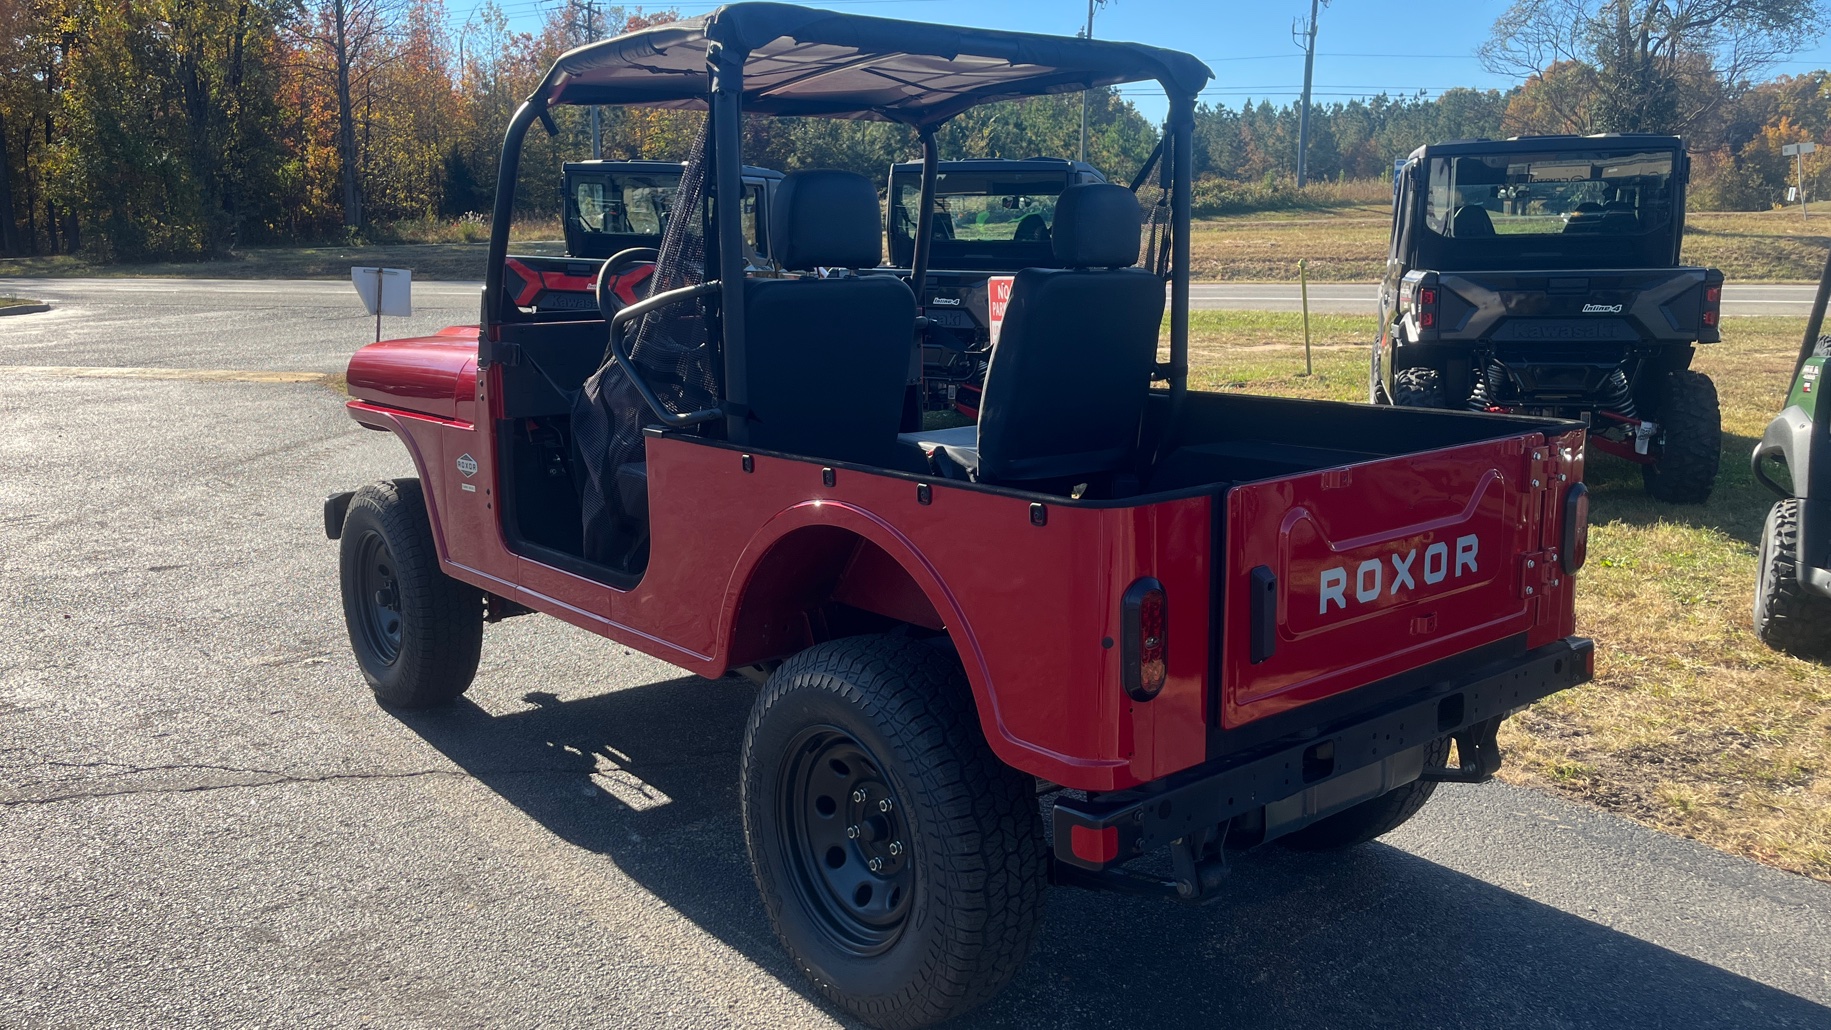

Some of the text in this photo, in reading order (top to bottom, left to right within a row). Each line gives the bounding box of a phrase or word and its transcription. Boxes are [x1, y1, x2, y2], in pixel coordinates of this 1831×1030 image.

[997, 285, 1009, 300] NO
[551, 294, 598, 309] Kawasa
[1513, 319, 1619, 339] Kawasaki
[457, 460, 477, 471] ROXOR
[1319, 533, 1479, 615] ROXOR
